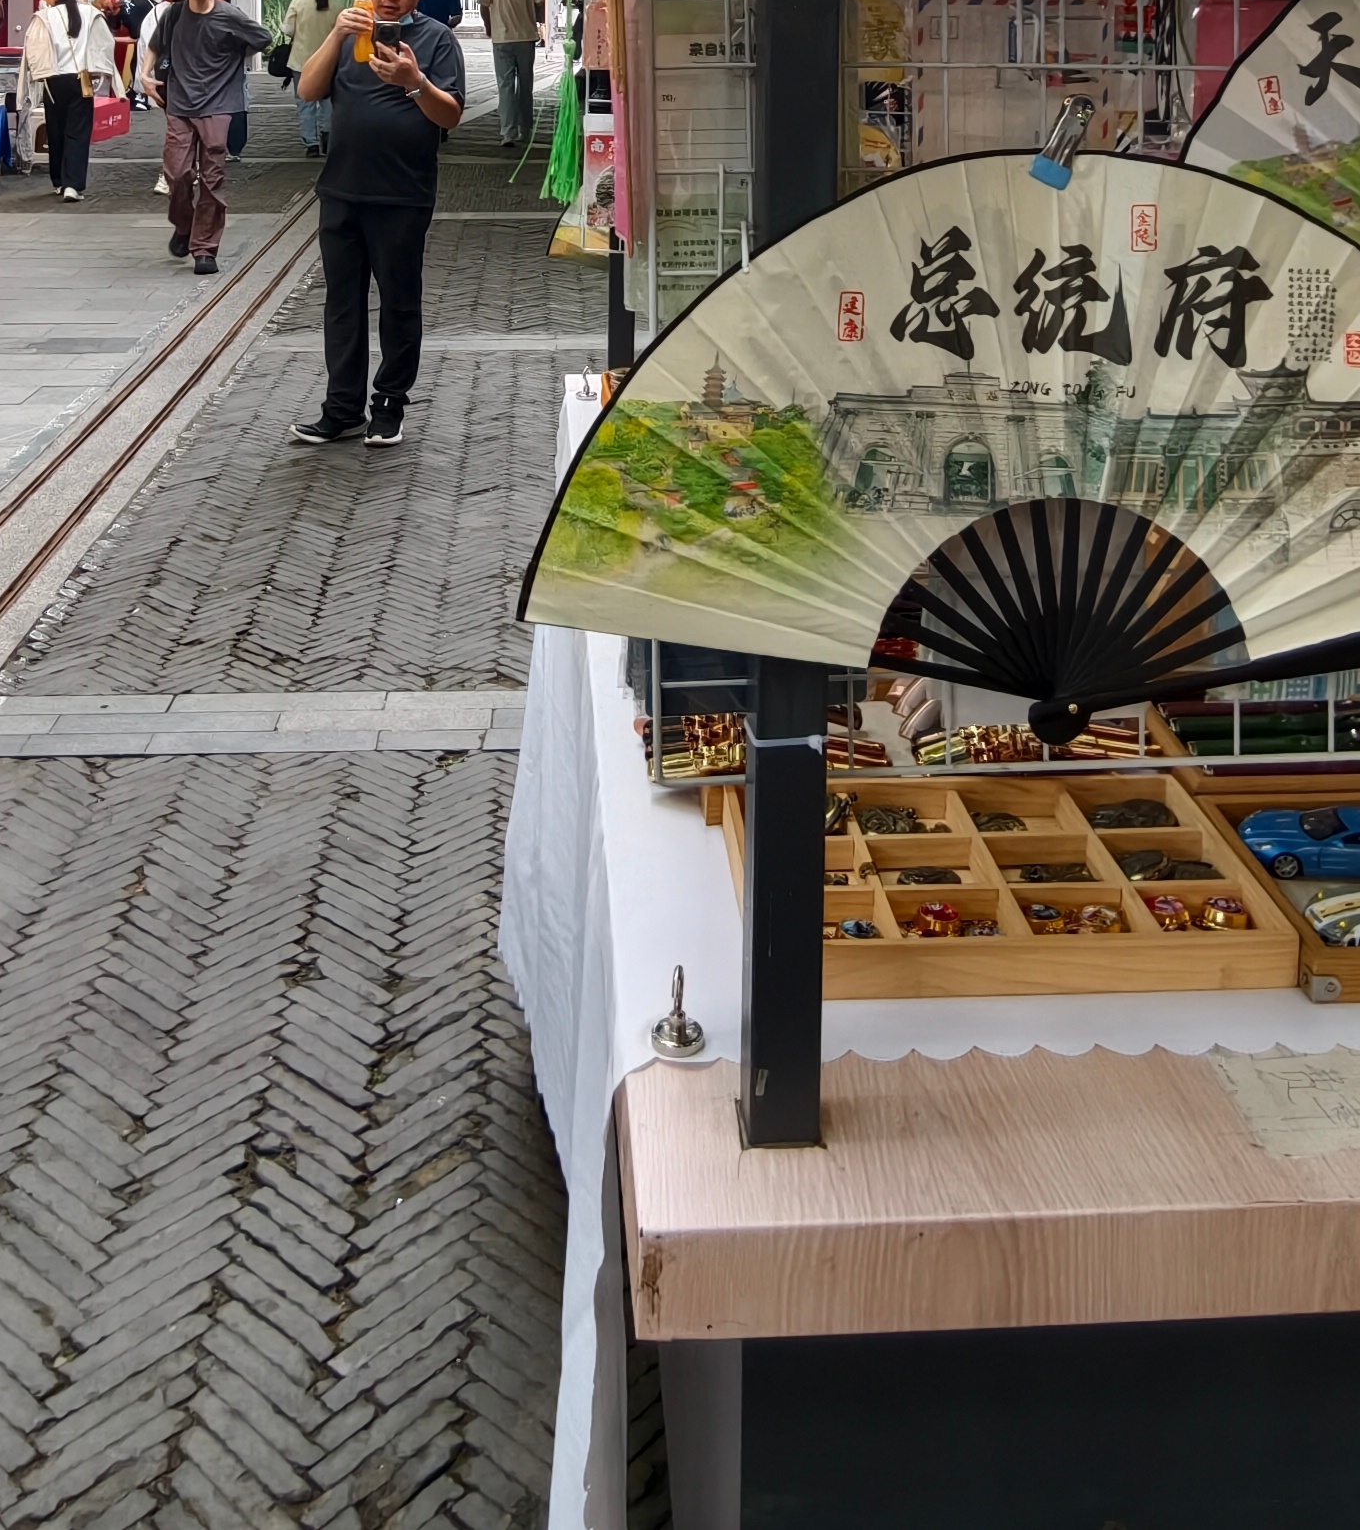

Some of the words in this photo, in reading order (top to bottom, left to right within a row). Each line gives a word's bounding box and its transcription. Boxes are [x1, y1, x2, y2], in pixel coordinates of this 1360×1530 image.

[889, 225, 1274, 368] 总统府
[1116, 385, 1136, 399] FU
